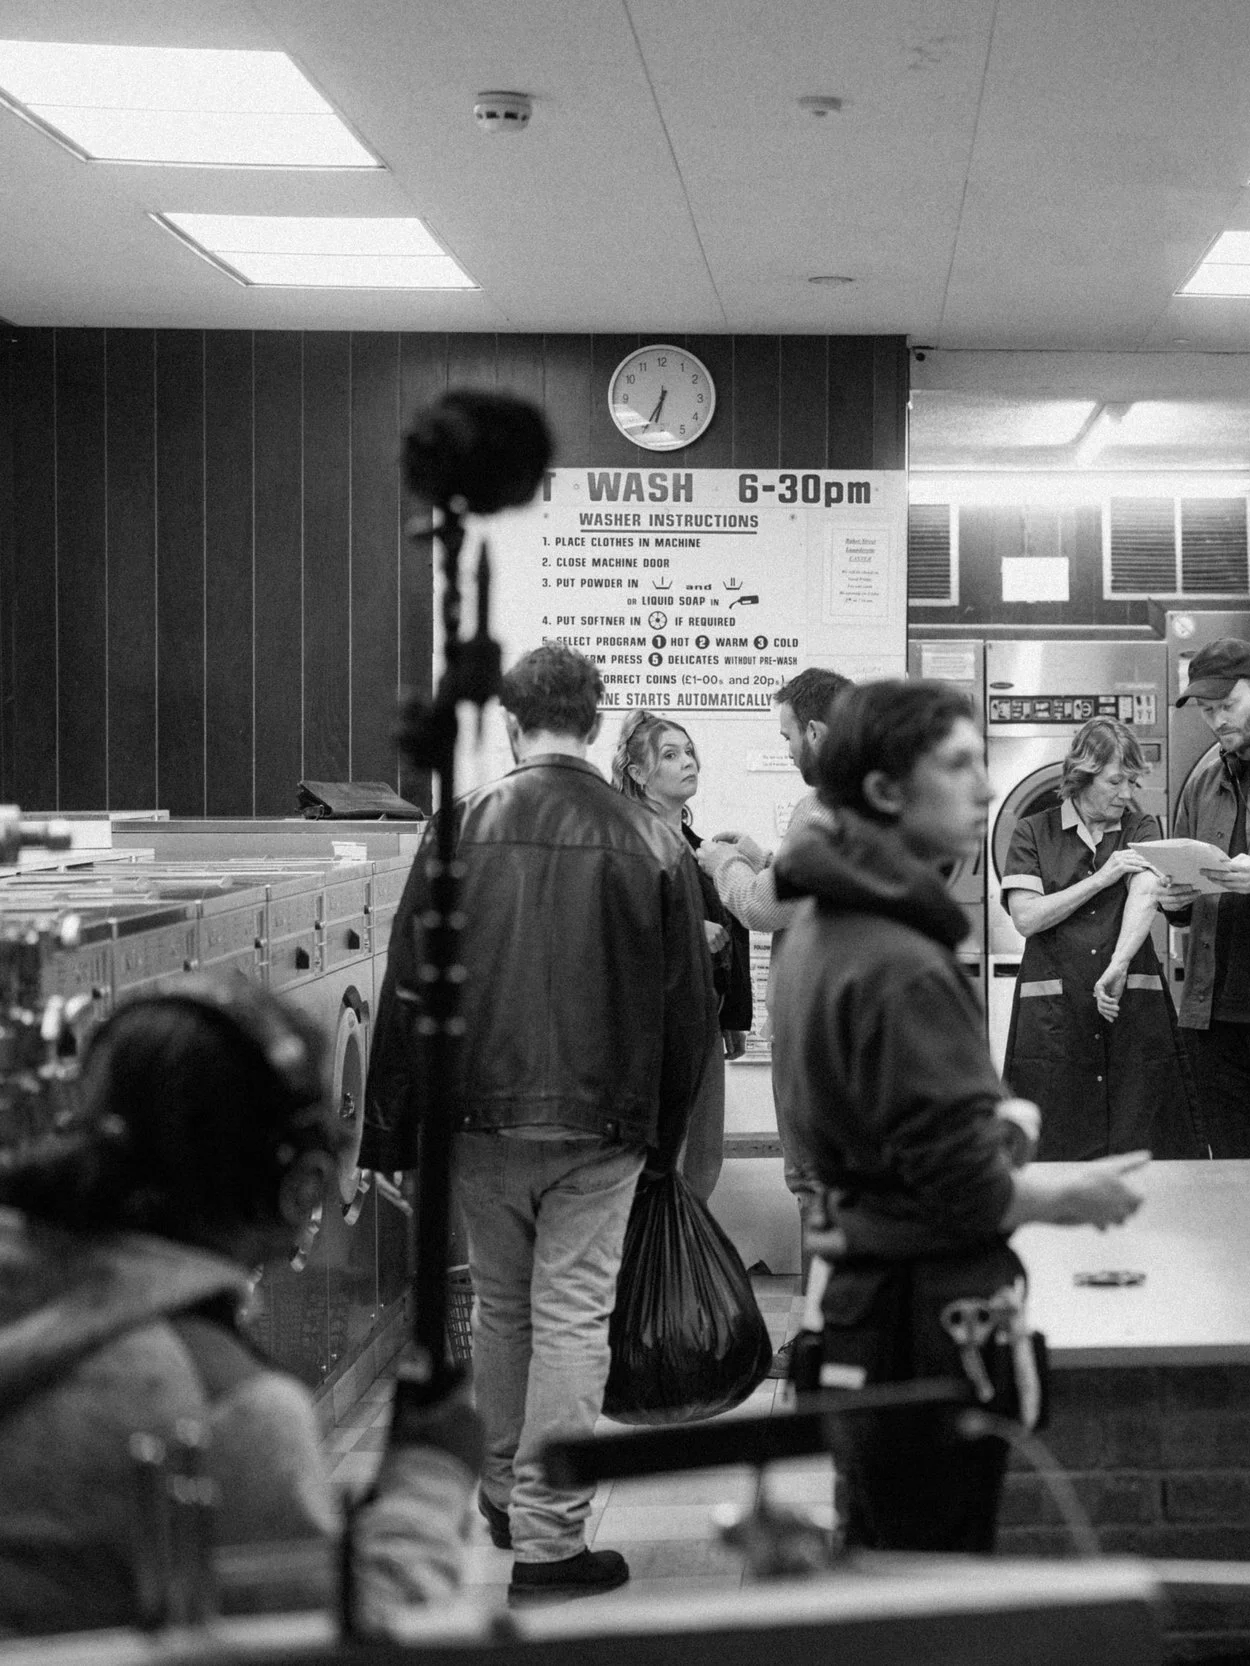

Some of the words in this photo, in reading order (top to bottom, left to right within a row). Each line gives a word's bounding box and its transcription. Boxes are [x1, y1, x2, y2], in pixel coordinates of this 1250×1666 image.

[640, 362, 647, 372] 11
[657, 357, 667, 367] 12
[680, 362, 685, 372] 1
[626, 374, 636, 385] 10
[691, 374, 699, 385] 2
[622, 393, 629, 404] 9
[696, 393, 704, 404] 3
[692, 412, 698, 421] 4
[679, 425, 686, 435] 5
[587, 472, 693, 502] WASH
[738, 473, 871, 508] 6-30pm
[579, 513, 641, 527] WASHER
[649, 513, 759, 528] INSTRUCTIONS
[542, 536, 550, 547] 1.
[555, 537, 586, 547] PLACE
[591, 537, 634, 548] CLOTHES
[638, 538, 650, 548] IN
[654, 538, 701, 548] MACHINE
[541, 557, 552, 567] 2.
[556, 557, 587, 568] CLOSE
[591, 558, 638, 568] MACHINE
[643, 558, 670, 568] DOOR
[541, 577, 552, 588] 3.
[556, 578, 576, 588] PUT
[580, 578, 623, 589] POWDER
[627, 579, 639, 588] IN
[685, 583, 712, 591] and
[626, 597, 637, 606] OR
[641, 596, 674, 606] LIQUID
[678, 596, 706, 606] SOAP
[710, 598, 720, 607] IN
[541, 615, 552, 626] 4.
[556, 616, 576, 626] PUT
[580, 616, 626, 626] SOFTNER
[630, 616, 642, 626] IN
[674, 617, 683, 627] IF
[688, 617, 736, 627] REQUIRED
[596, 636, 647, 647] PROGRAM
[670, 637, 690, 647] HOT
[715, 637, 749, 648] WARM
[773, 638, 799, 648] COLD
[610, 655, 643, 665] PRESS
[667, 655, 720, 665] DELICATES
[724, 656, 757, 665] WITHOUT
[759, 656, 798, 666] PRE-WASH
[645, 674, 677, 685] COINS
[728, 675, 750, 685] and
[626, 692, 671, 706] STARTS
[676, 693, 773, 706] AUTOMATICALLY
